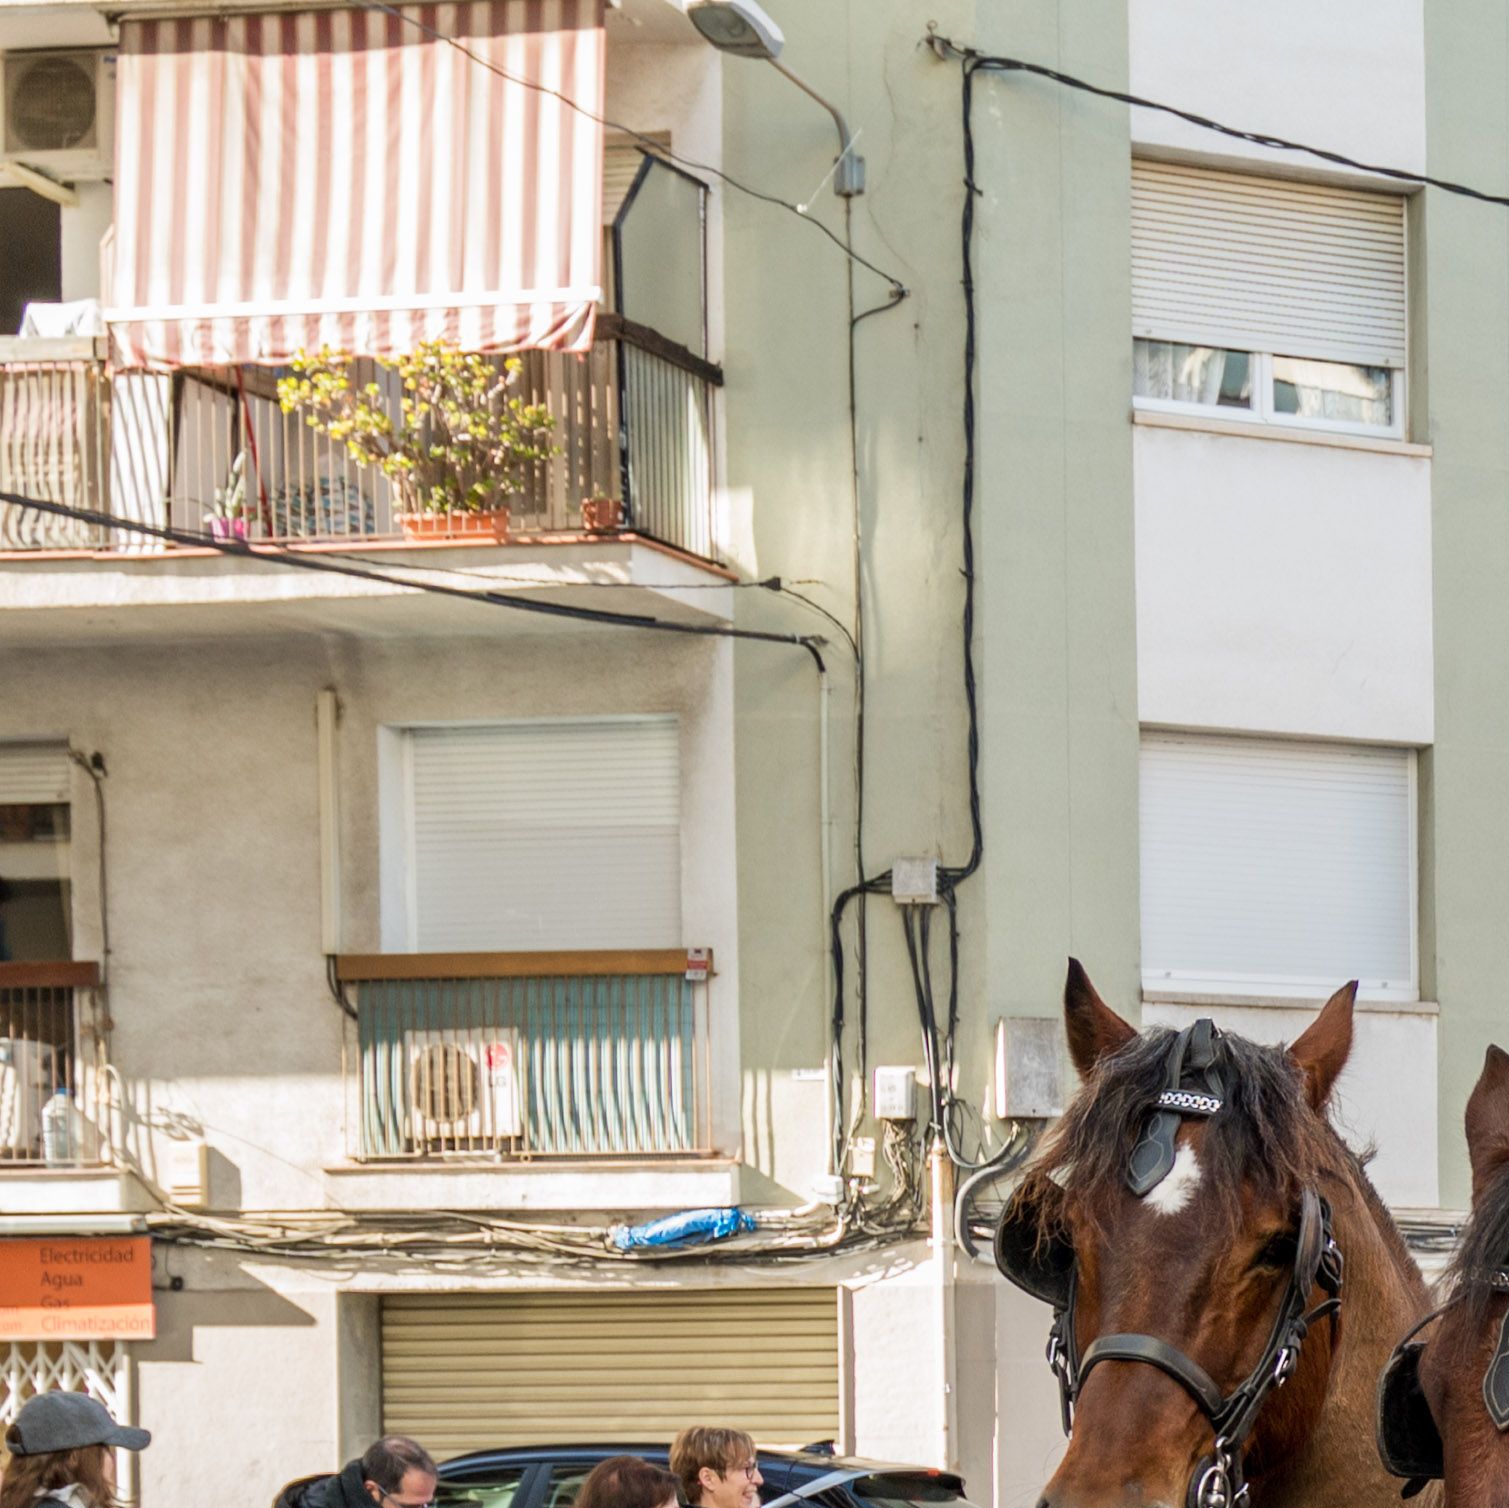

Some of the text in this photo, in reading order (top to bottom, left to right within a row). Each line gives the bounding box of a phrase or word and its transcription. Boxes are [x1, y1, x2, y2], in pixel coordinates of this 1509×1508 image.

[39, 1247, 134, 1265] Electricidad
[40, 1271, 83, 1290] Agua
[41, 1296, 71, 1312] Gas
[41, 1314, 150, 1332] Climatización
